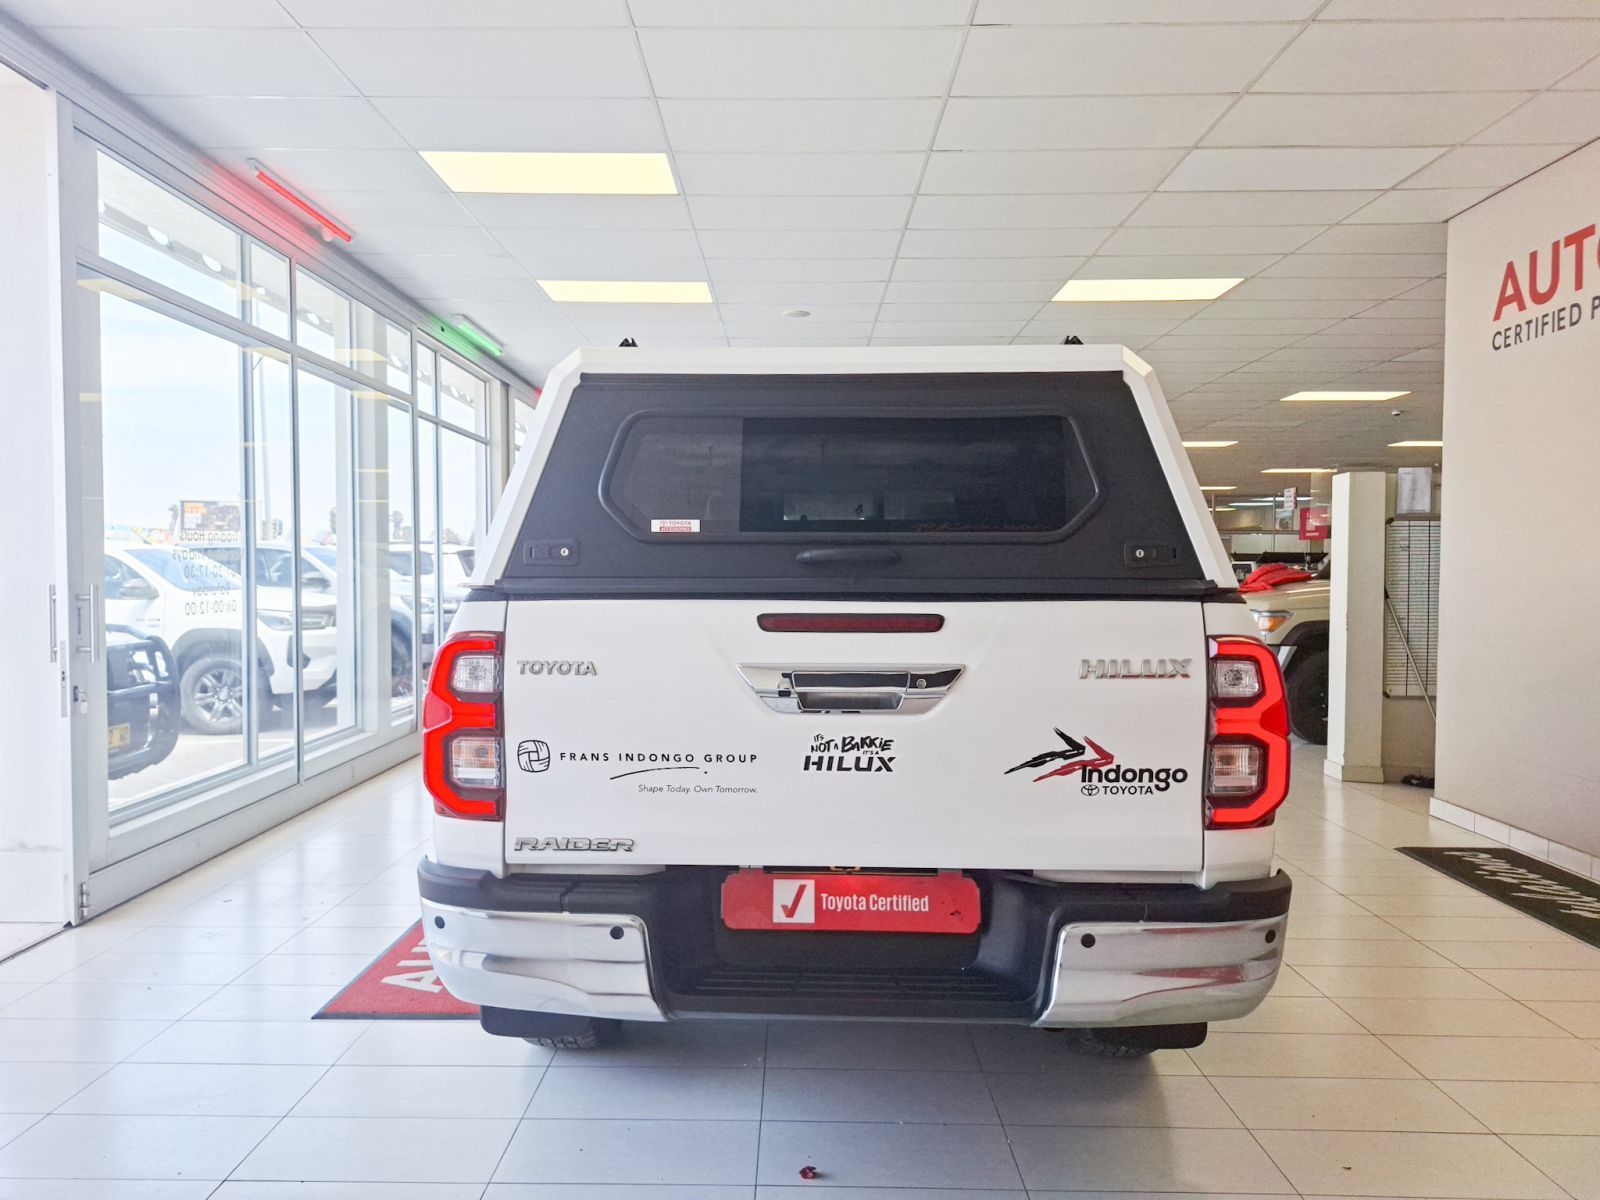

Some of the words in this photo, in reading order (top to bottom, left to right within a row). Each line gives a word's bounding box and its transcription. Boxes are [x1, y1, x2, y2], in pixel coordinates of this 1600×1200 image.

[1493, 223, 1600, 322] AUT
[1492, 302, 1582, 351] CERTIFIED
[517, 660, 597, 676] TOYOTA
[1079, 658, 1192, 680] HILUX
[810, 738, 835, 753] NOT
[560, 752, 609, 762] FRANS
[618, 752, 695, 763] INDONGO
[704, 753, 758, 764] GROUP
[803, 755, 897, 773] HILUX
[1081, 764, 1188, 792] Indongo
[638, 784, 663, 793] Shape
[667, 785, 691, 794] Today.
[693, 785, 713, 793] Own
[716, 785, 757, 793] Tomorrow.
[1102, 785, 1154, 796] TOYOTA
[514, 837, 635, 852] RAIDER
[821, 892, 866, 912] Toyota
[869, 893, 929, 913] Certified
